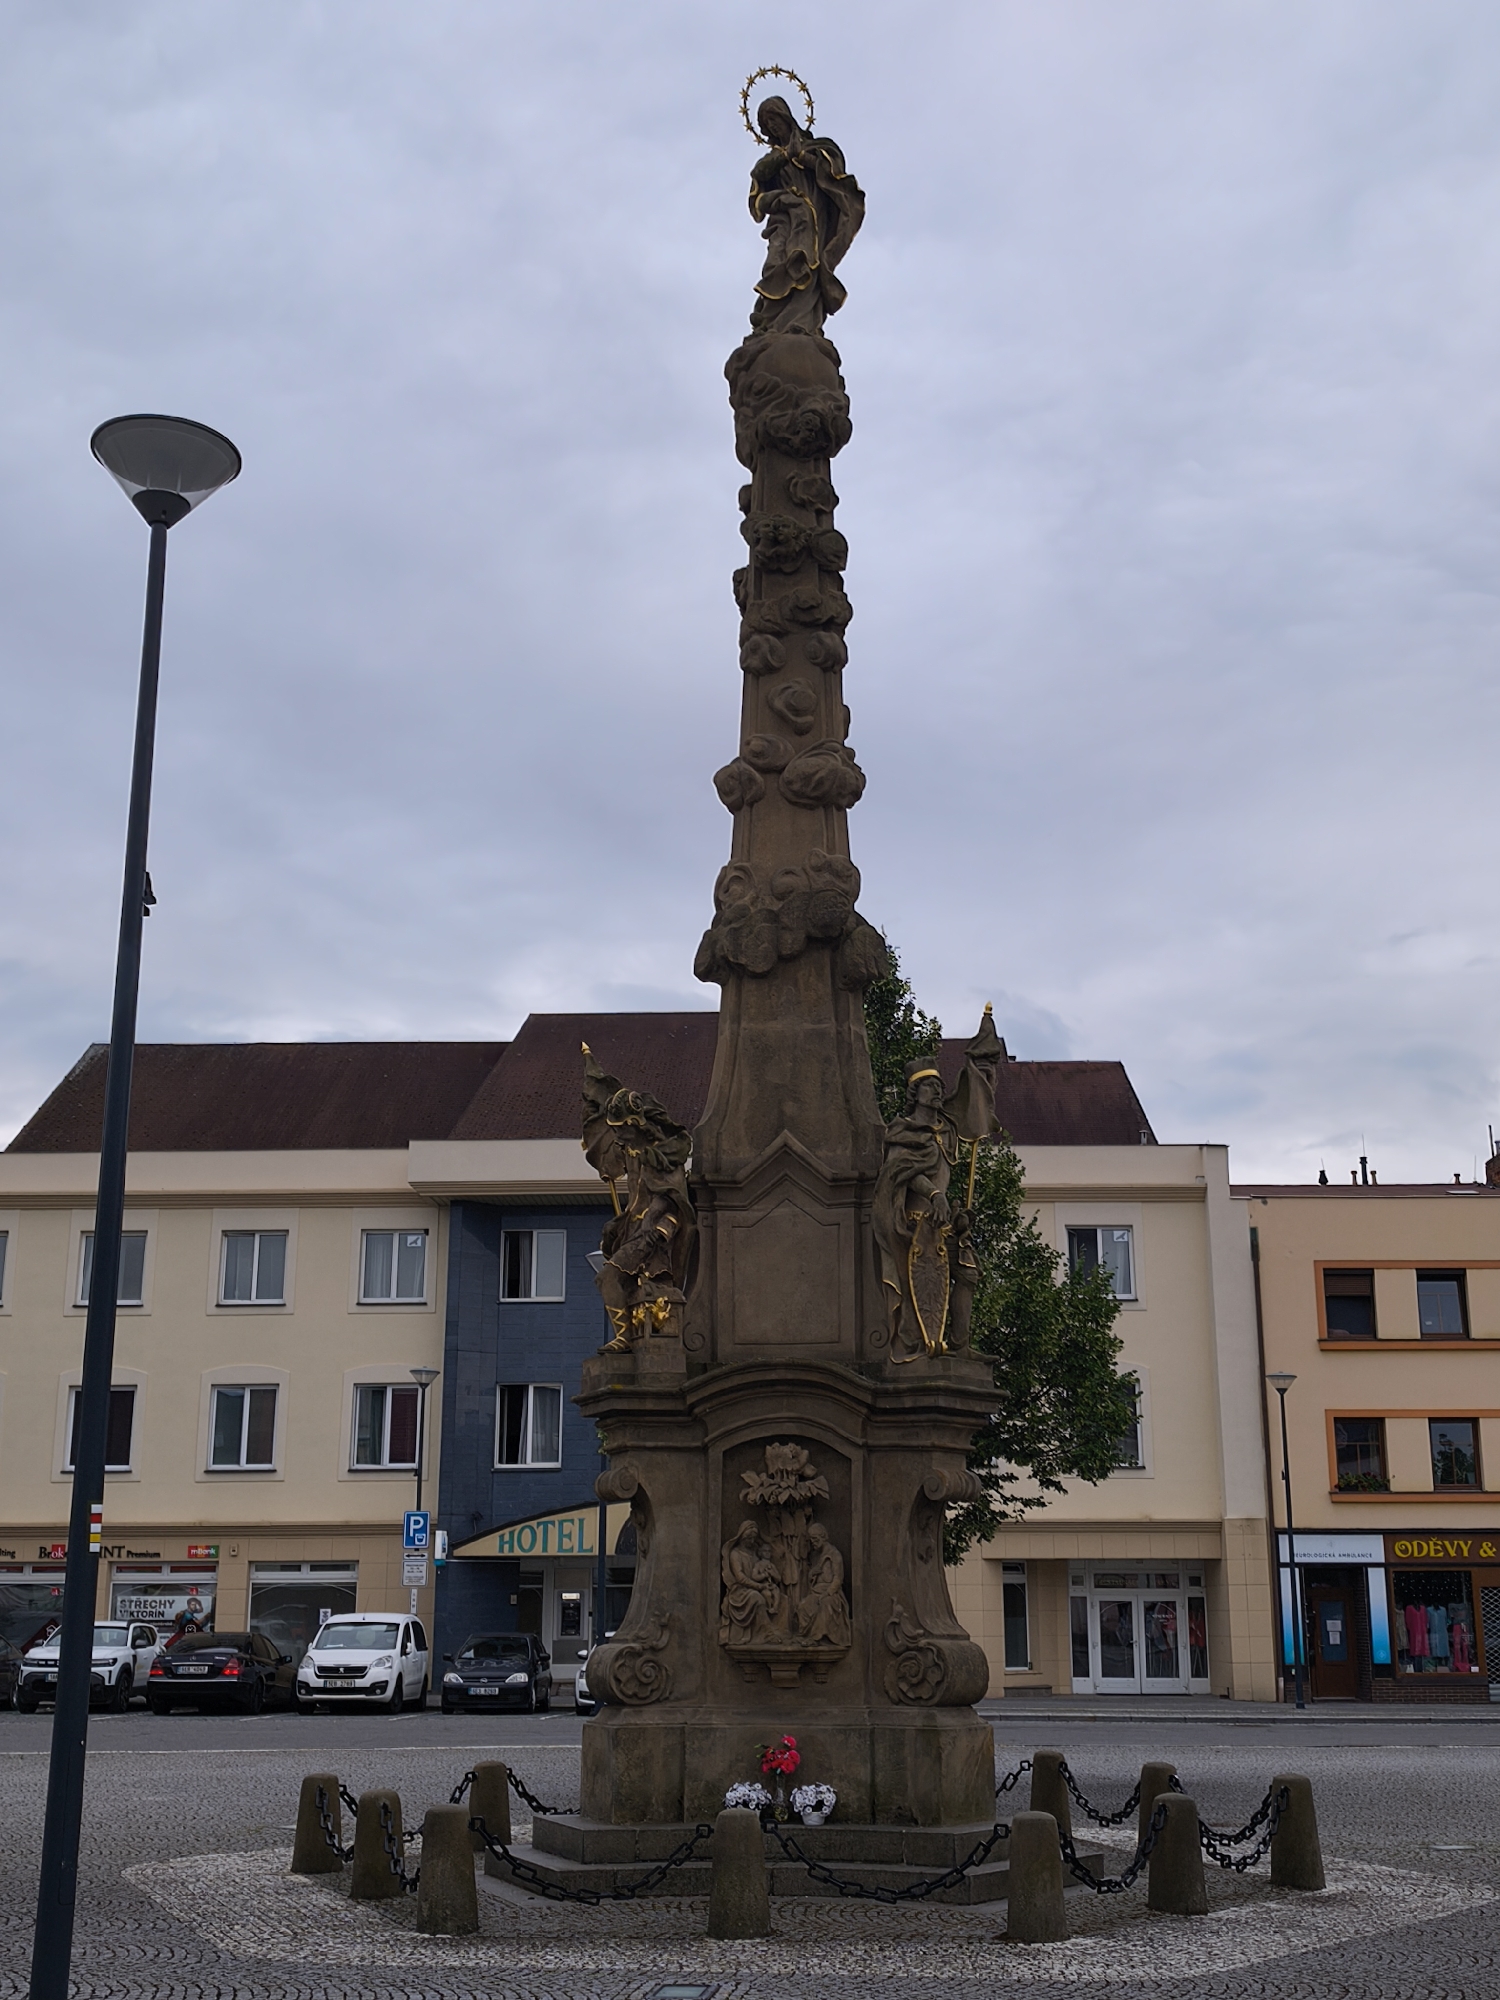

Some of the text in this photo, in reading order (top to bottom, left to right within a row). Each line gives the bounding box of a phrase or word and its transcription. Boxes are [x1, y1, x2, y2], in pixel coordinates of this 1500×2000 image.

[409, 1515, 424, 1537] P
[498, 1518, 593, 1553] HOTEL
[190, 1547, 216, 1555] mBank
[1394, 1536, 1497, 1558] ODĚVY &
[126, 1549, 161, 1559] Premium
[120, 1597, 175, 1609] STŘECHY
[120, 1608, 165, 1618] VIKTORÍN
